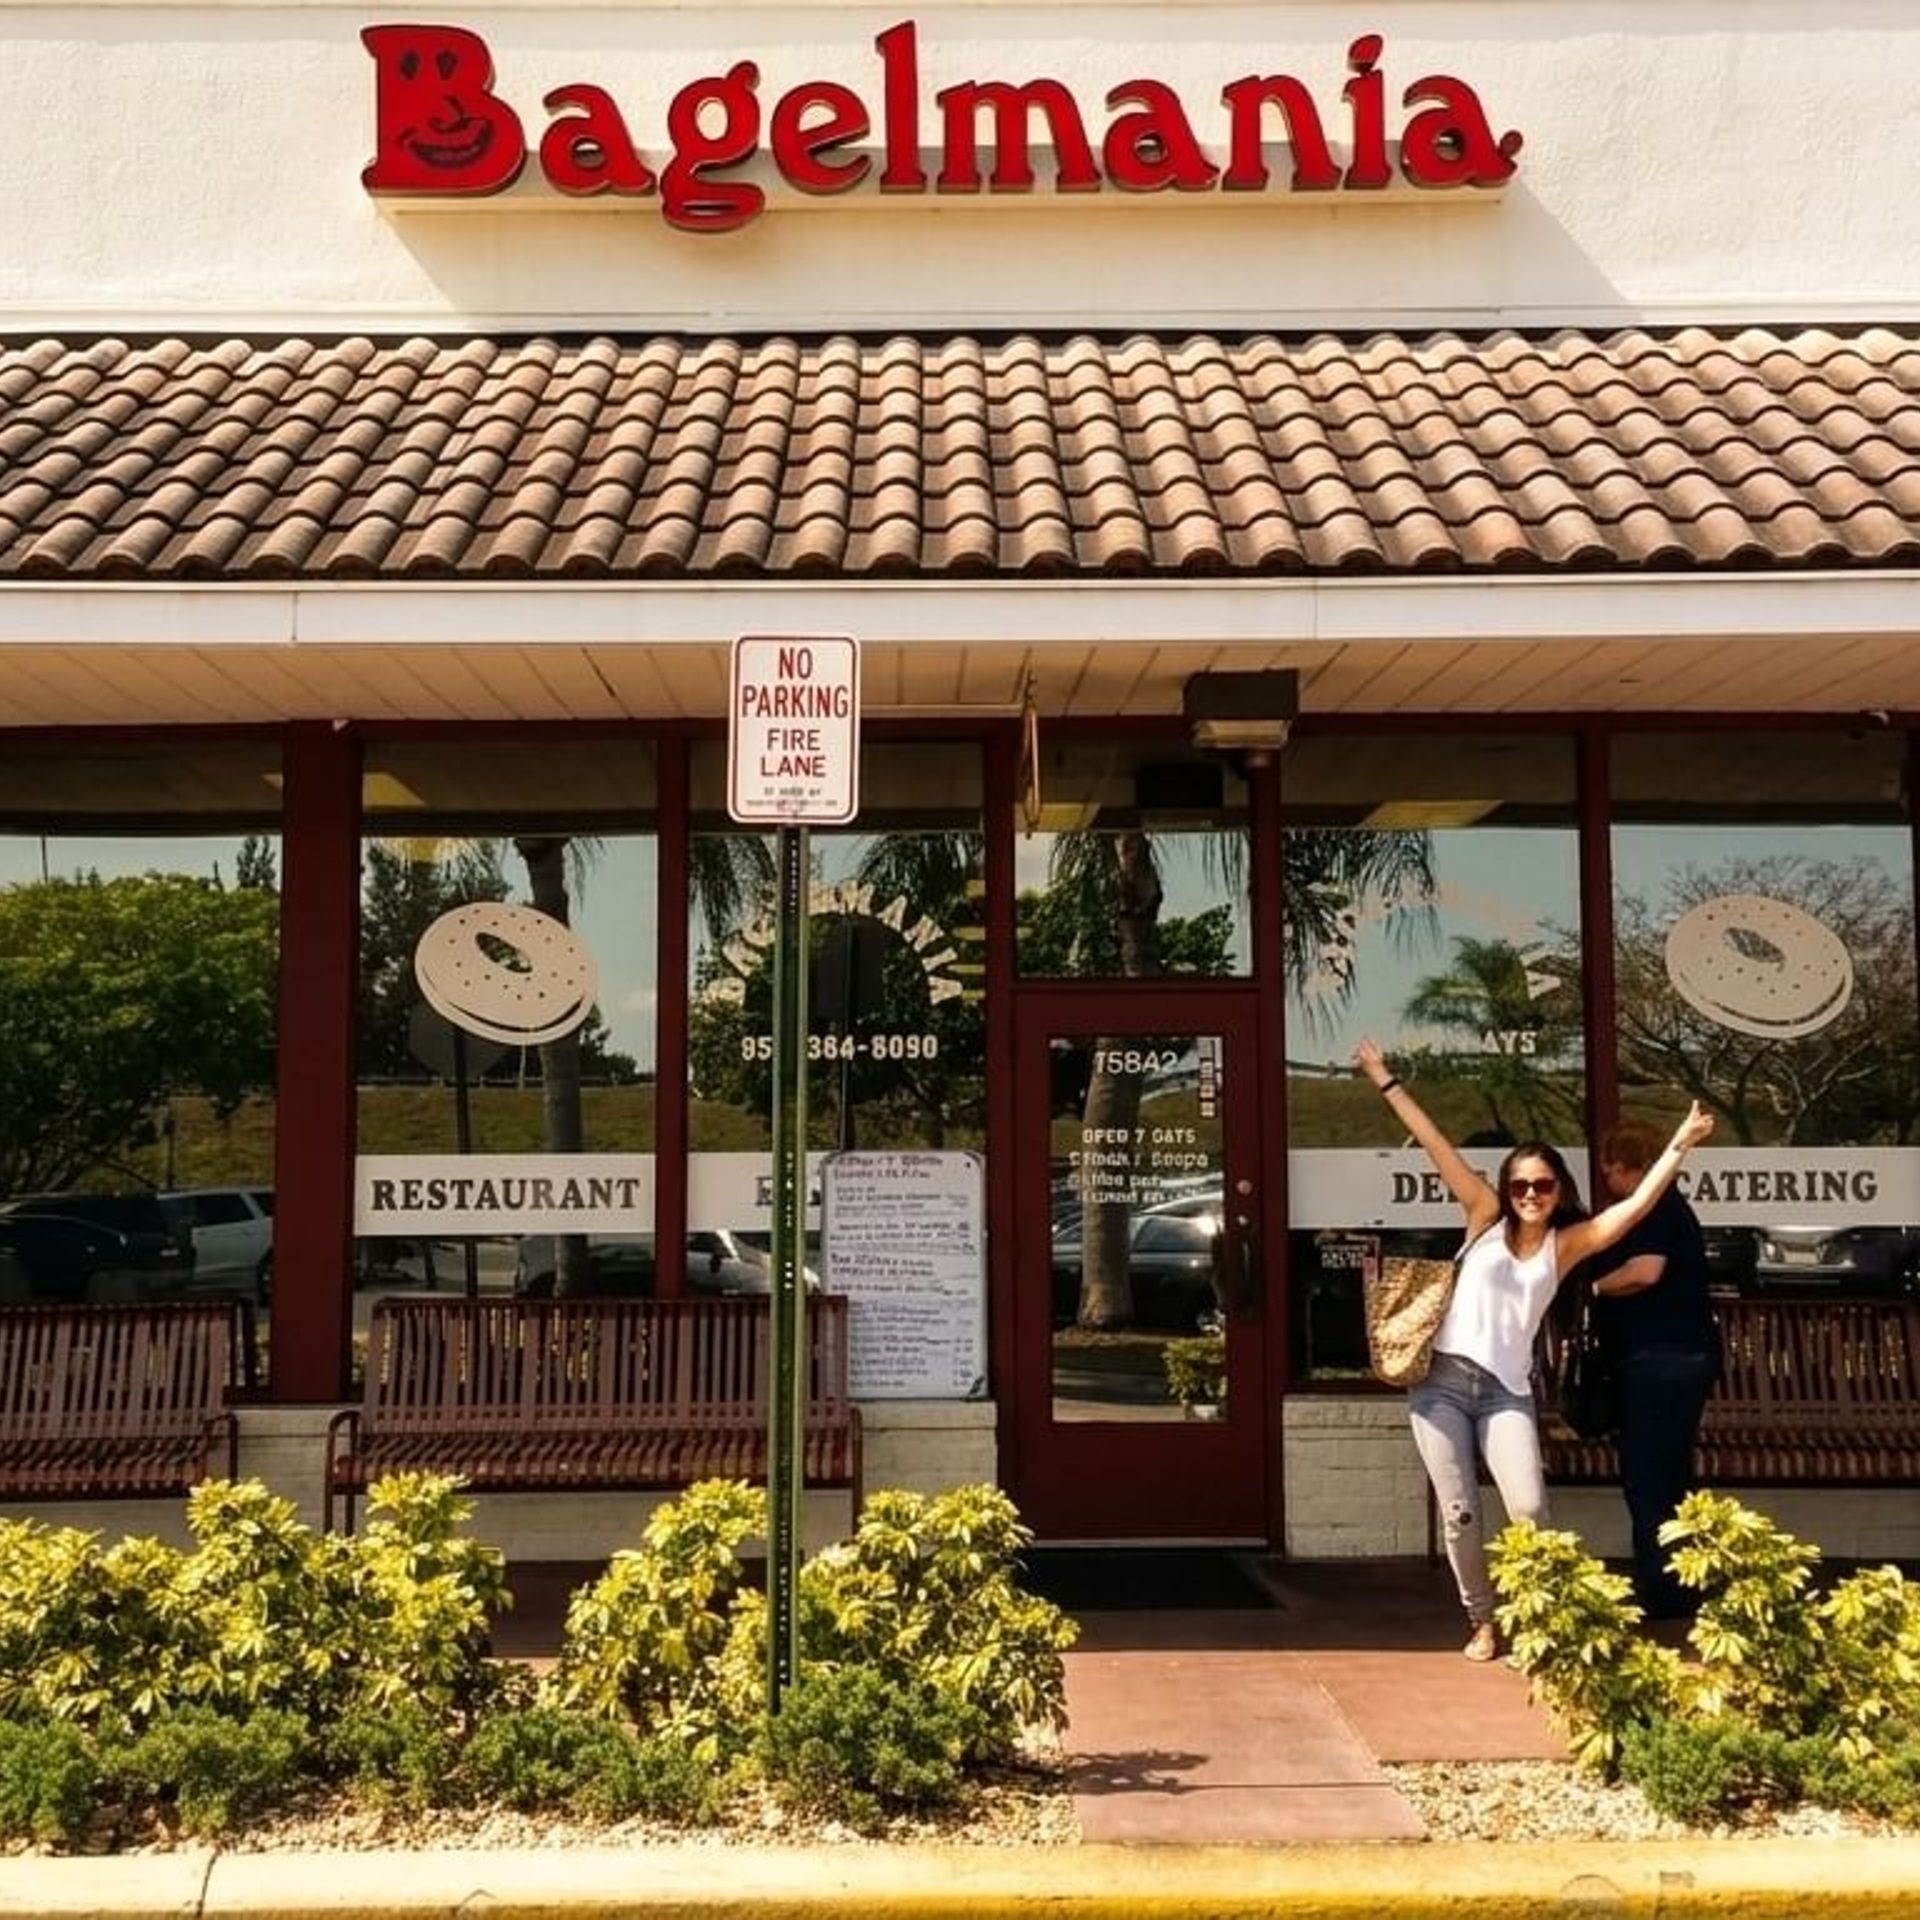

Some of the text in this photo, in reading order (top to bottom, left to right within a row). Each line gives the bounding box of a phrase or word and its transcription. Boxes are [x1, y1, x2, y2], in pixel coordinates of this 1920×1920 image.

[361, 20, 1523, 232] Bagelmania
[778, 647, 814, 680] NO
[741, 684, 849, 719] PARKING
[766, 728, 821, 751] FIRE
[760, 755, 826, 778] LANE
[371, 1177, 640, 1210] RESTAURANT
